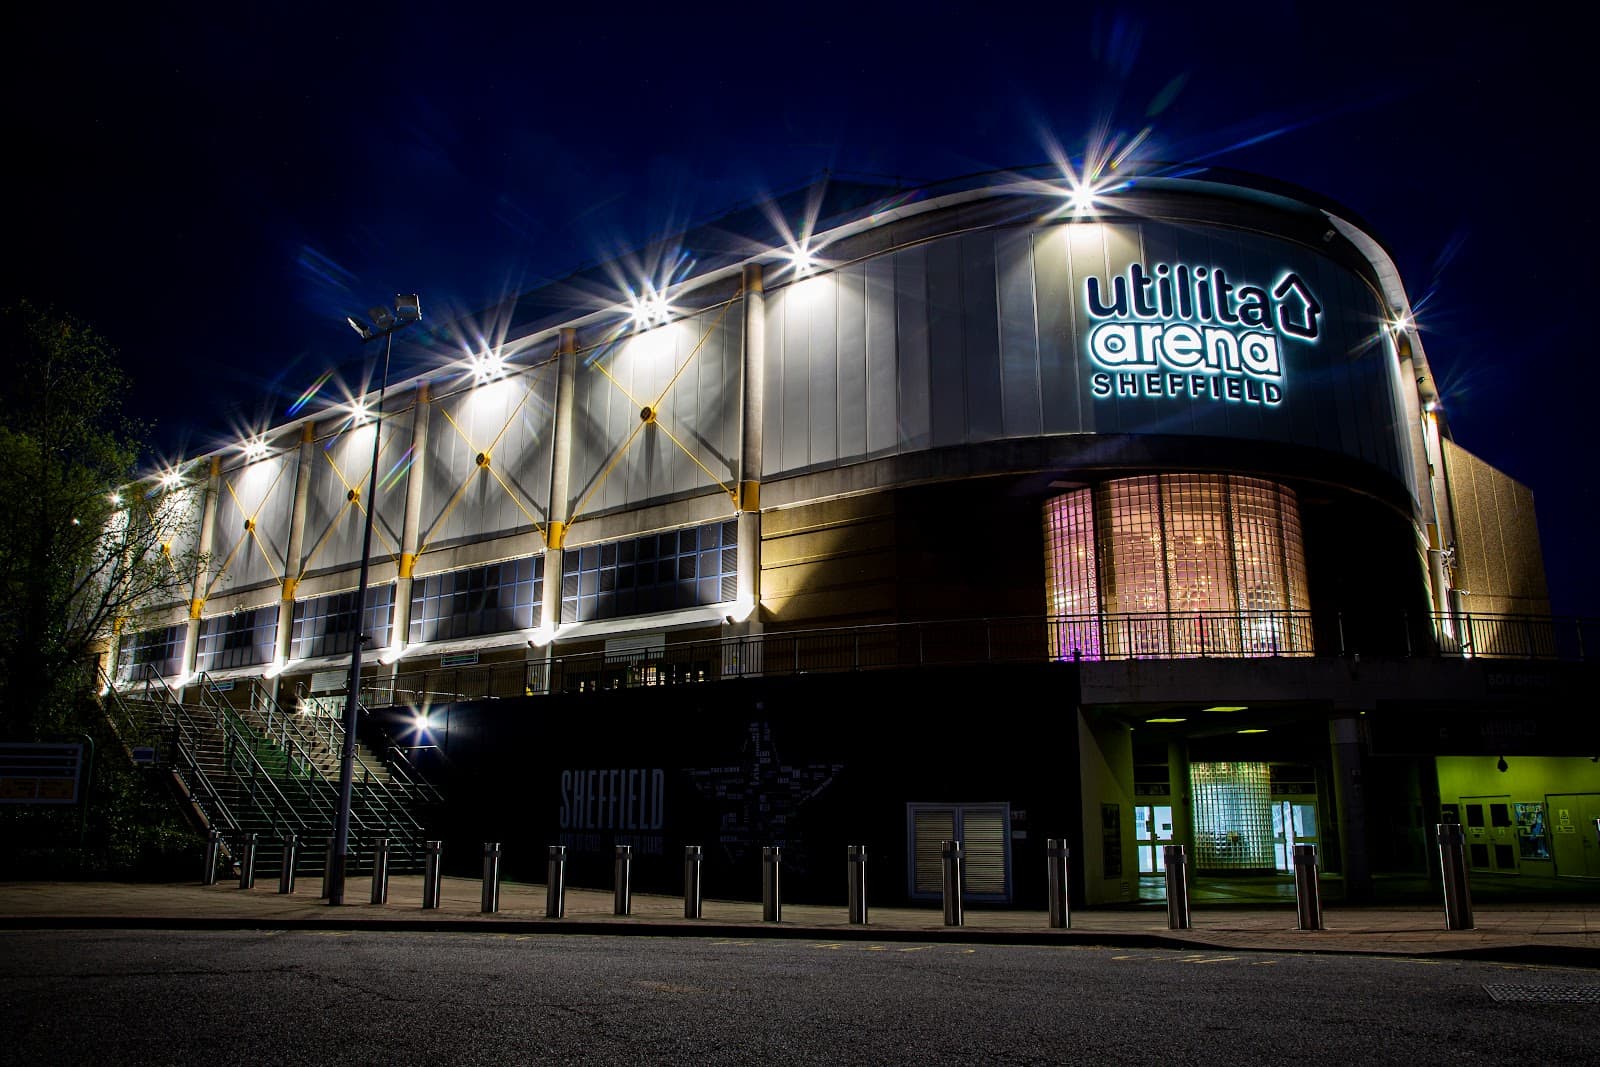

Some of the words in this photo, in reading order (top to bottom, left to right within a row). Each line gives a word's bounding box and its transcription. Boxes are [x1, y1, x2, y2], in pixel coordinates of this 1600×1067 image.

[1087, 264, 1272, 328] utilita
[1092, 322, 1281, 376] arena
[1094, 373, 1281, 402] SHEFFIELD
[560, 768, 665, 830] SHEFFIELD
